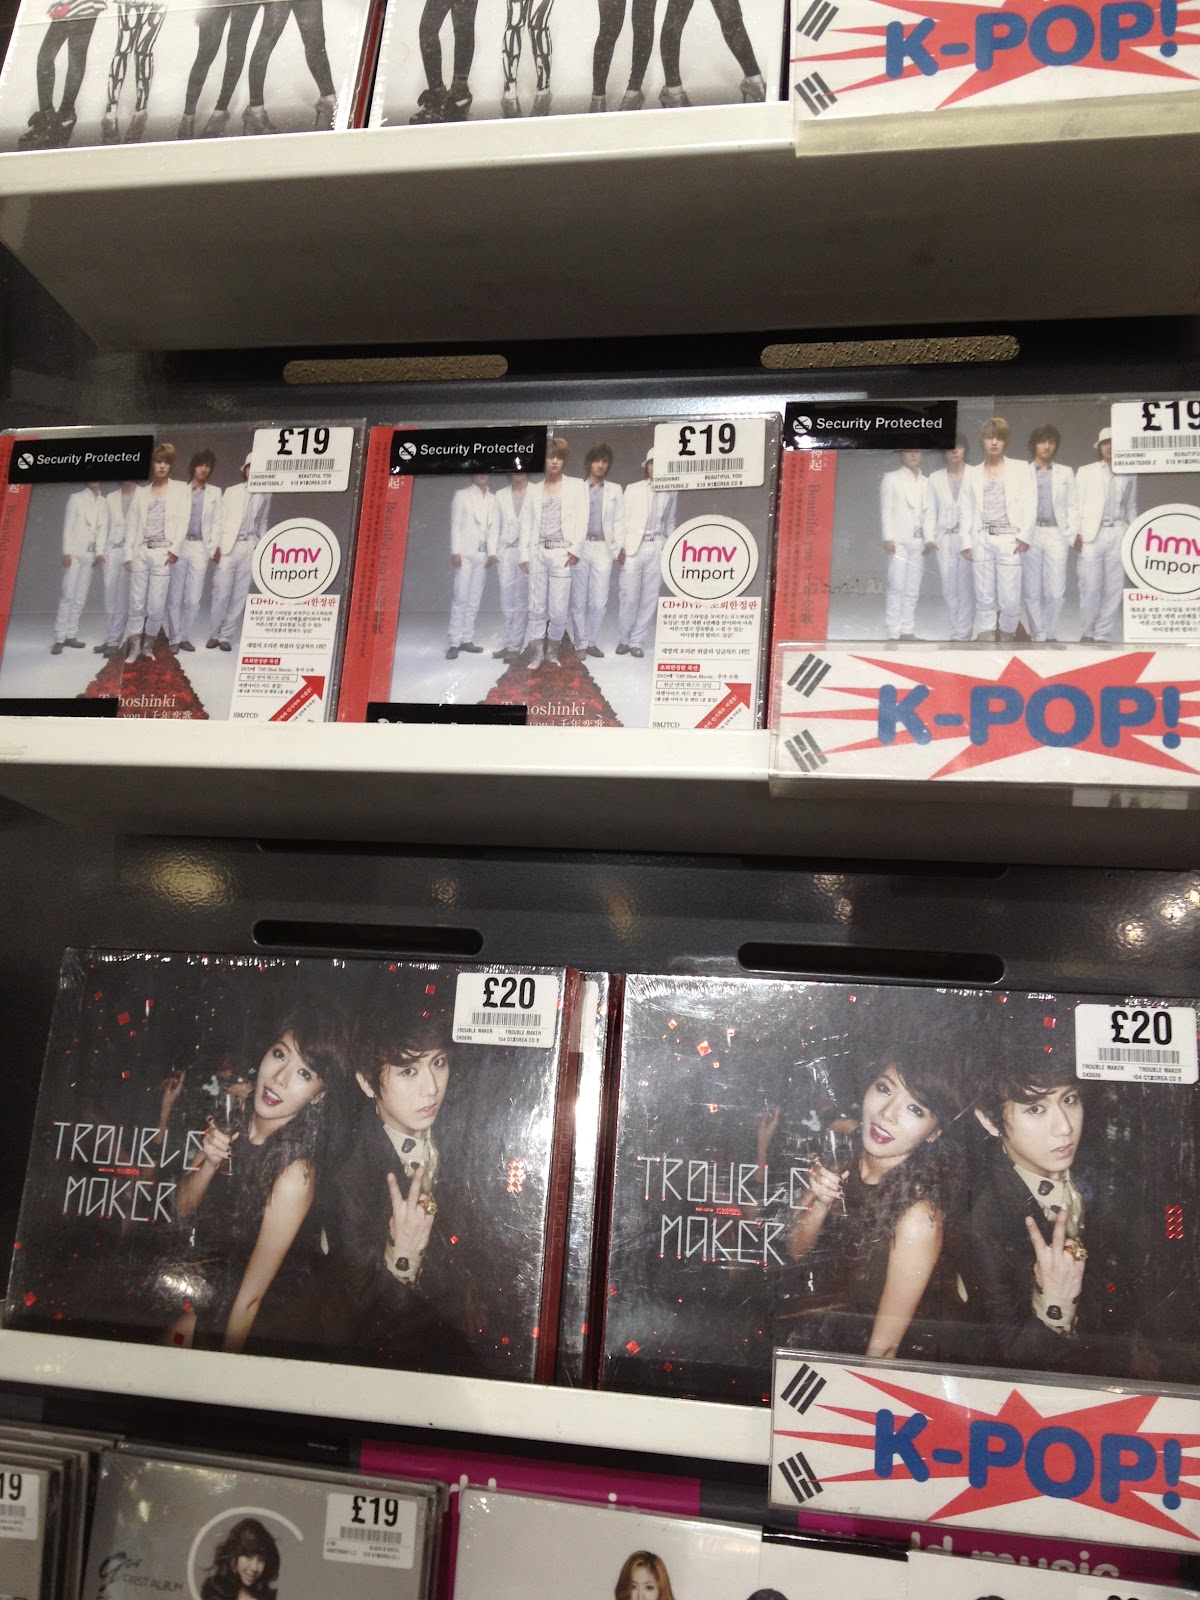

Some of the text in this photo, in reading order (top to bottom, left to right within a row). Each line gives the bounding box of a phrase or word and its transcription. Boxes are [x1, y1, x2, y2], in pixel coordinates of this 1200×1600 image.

[885, 0, 1178, 79] K-POP!
[816, 416, 942, 431] Security Protected
[1142, 401, 1200, 431] £19
[277, 428, 330, 455] £19
[420, 441, 533, 457] Security Protected
[679, 423, 736, 456] £19
[36, 451, 140, 466] Security Protected
[380, 501, 397, 551] Beautiful
[806, 484, 821, 536] Beautiful
[270, 543, 322, 564] hmv
[681, 540, 737, 564] hmv
[270, 566, 319, 583] import
[681, 566, 735, 583] import
[877, 683, 1181, 750] K-POP!
[482, 977, 536, 1010] £20
[1111, 1010, 1172, 1045] £20
[53, 1121, 206, 1171] TROUBLE
[62, 1176, 177, 1224] MAKER
[636, 1156, 813, 1212] TROUBLE
[659, 1214, 785, 1267] MAKER
[874, 1409, 1182, 1510] K-POP!
[352, 1496, 398, 1527] £19
